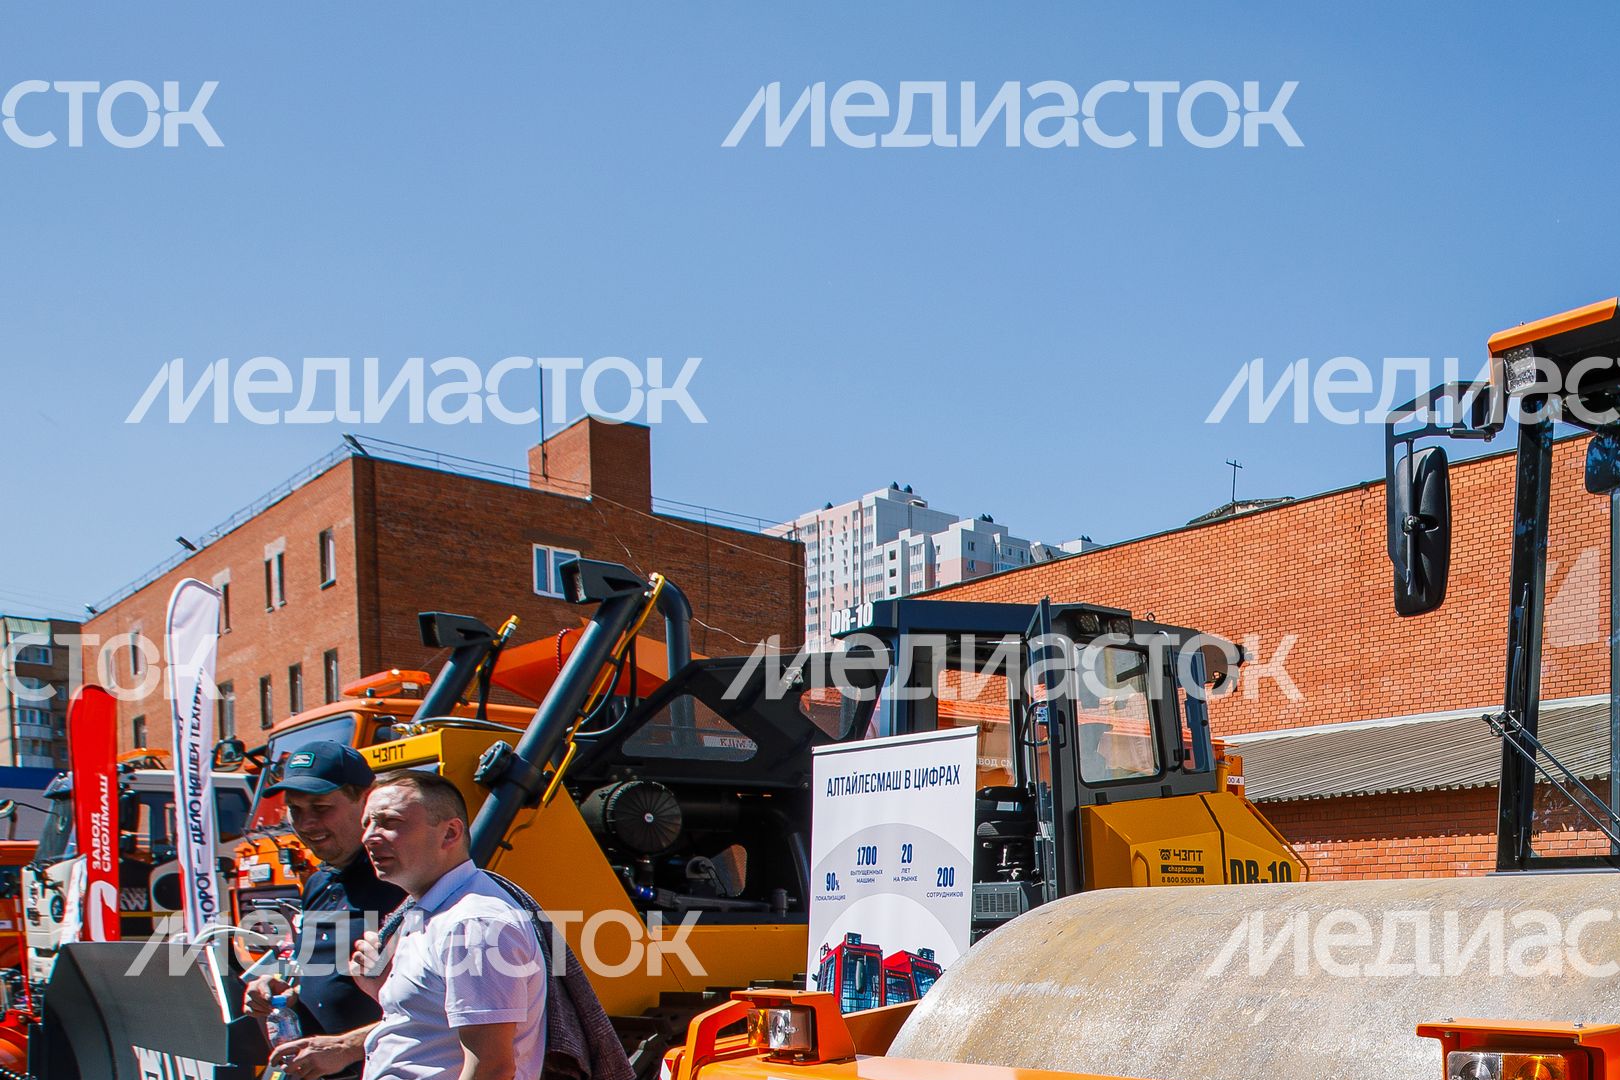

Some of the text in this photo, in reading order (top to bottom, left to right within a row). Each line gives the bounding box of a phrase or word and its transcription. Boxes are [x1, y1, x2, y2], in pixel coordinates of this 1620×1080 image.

[831, 602, 873, 635] DR-10
[373, 744, 406, 763] ЧЗПТ
[189, 742, 202, 797] НАШЕЙ
[826, 764, 961, 797] АЛТАЙЛЕСМАШ В ЦИФРАХ
[102, 775, 113, 873] СМОЛМАШ
[189, 800, 206, 845] ДЕЛО
[92, 812, 102, 871] ЗАВОД
[857, 845, 877, 866] 1700
[901, 843, 913, 863] 20
[1173, 849, 1204, 862] ЧЗПТ
[826, 872, 840, 891] 90%
[936, 866, 955, 887] 200
[1230, 858, 1292, 885] DR-10
[815, 894, 846, 902] ЛОКАЛИЗАЦИЯ
[927, 890, 964, 898] СОТРУДНИКОВ
